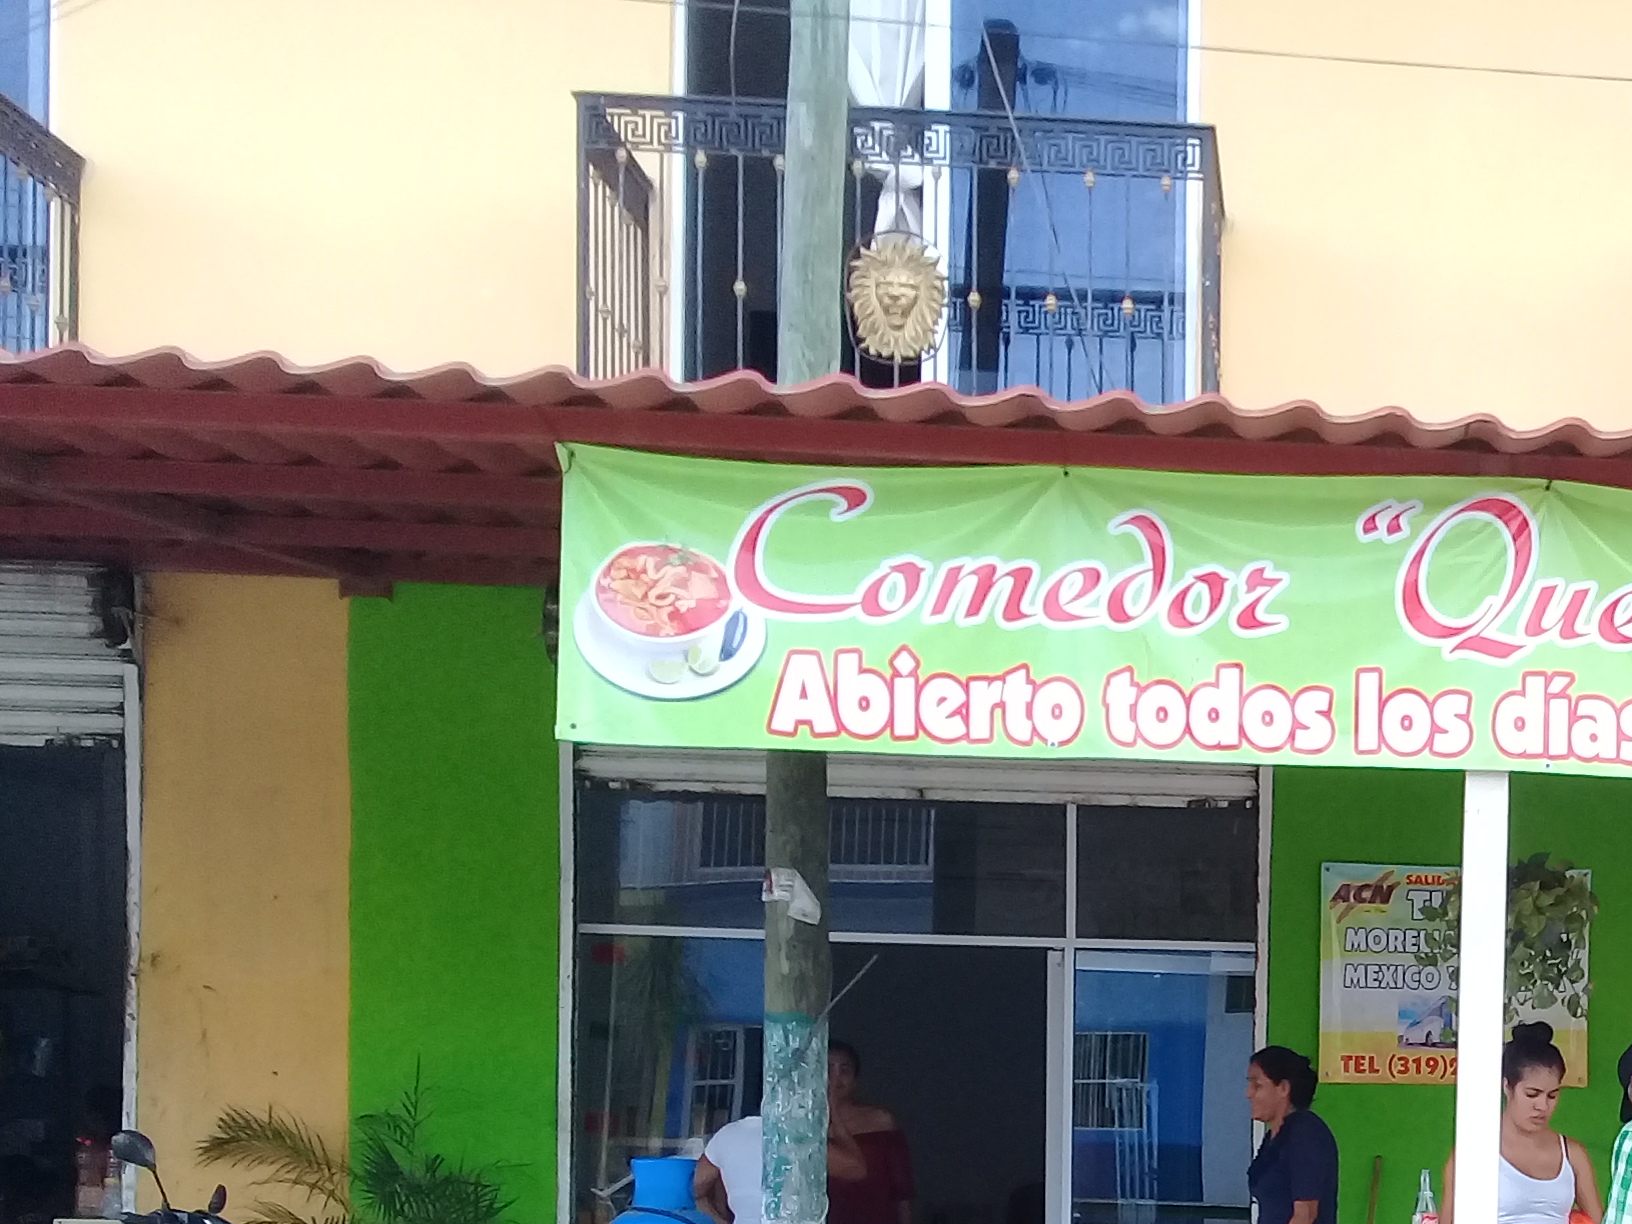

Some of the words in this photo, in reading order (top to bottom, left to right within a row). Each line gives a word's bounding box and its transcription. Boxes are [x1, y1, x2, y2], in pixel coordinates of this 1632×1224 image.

[731, 482, 1289, 633] Comedor
[767, 644, 1084, 747] Abierto
[1104, 662, 1334, 755] todos
[1355, 667, 1473, 758] los
[1343, 963, 1441, 991] MEXICO
[1340, 1055, 1380, 1075] TEL
